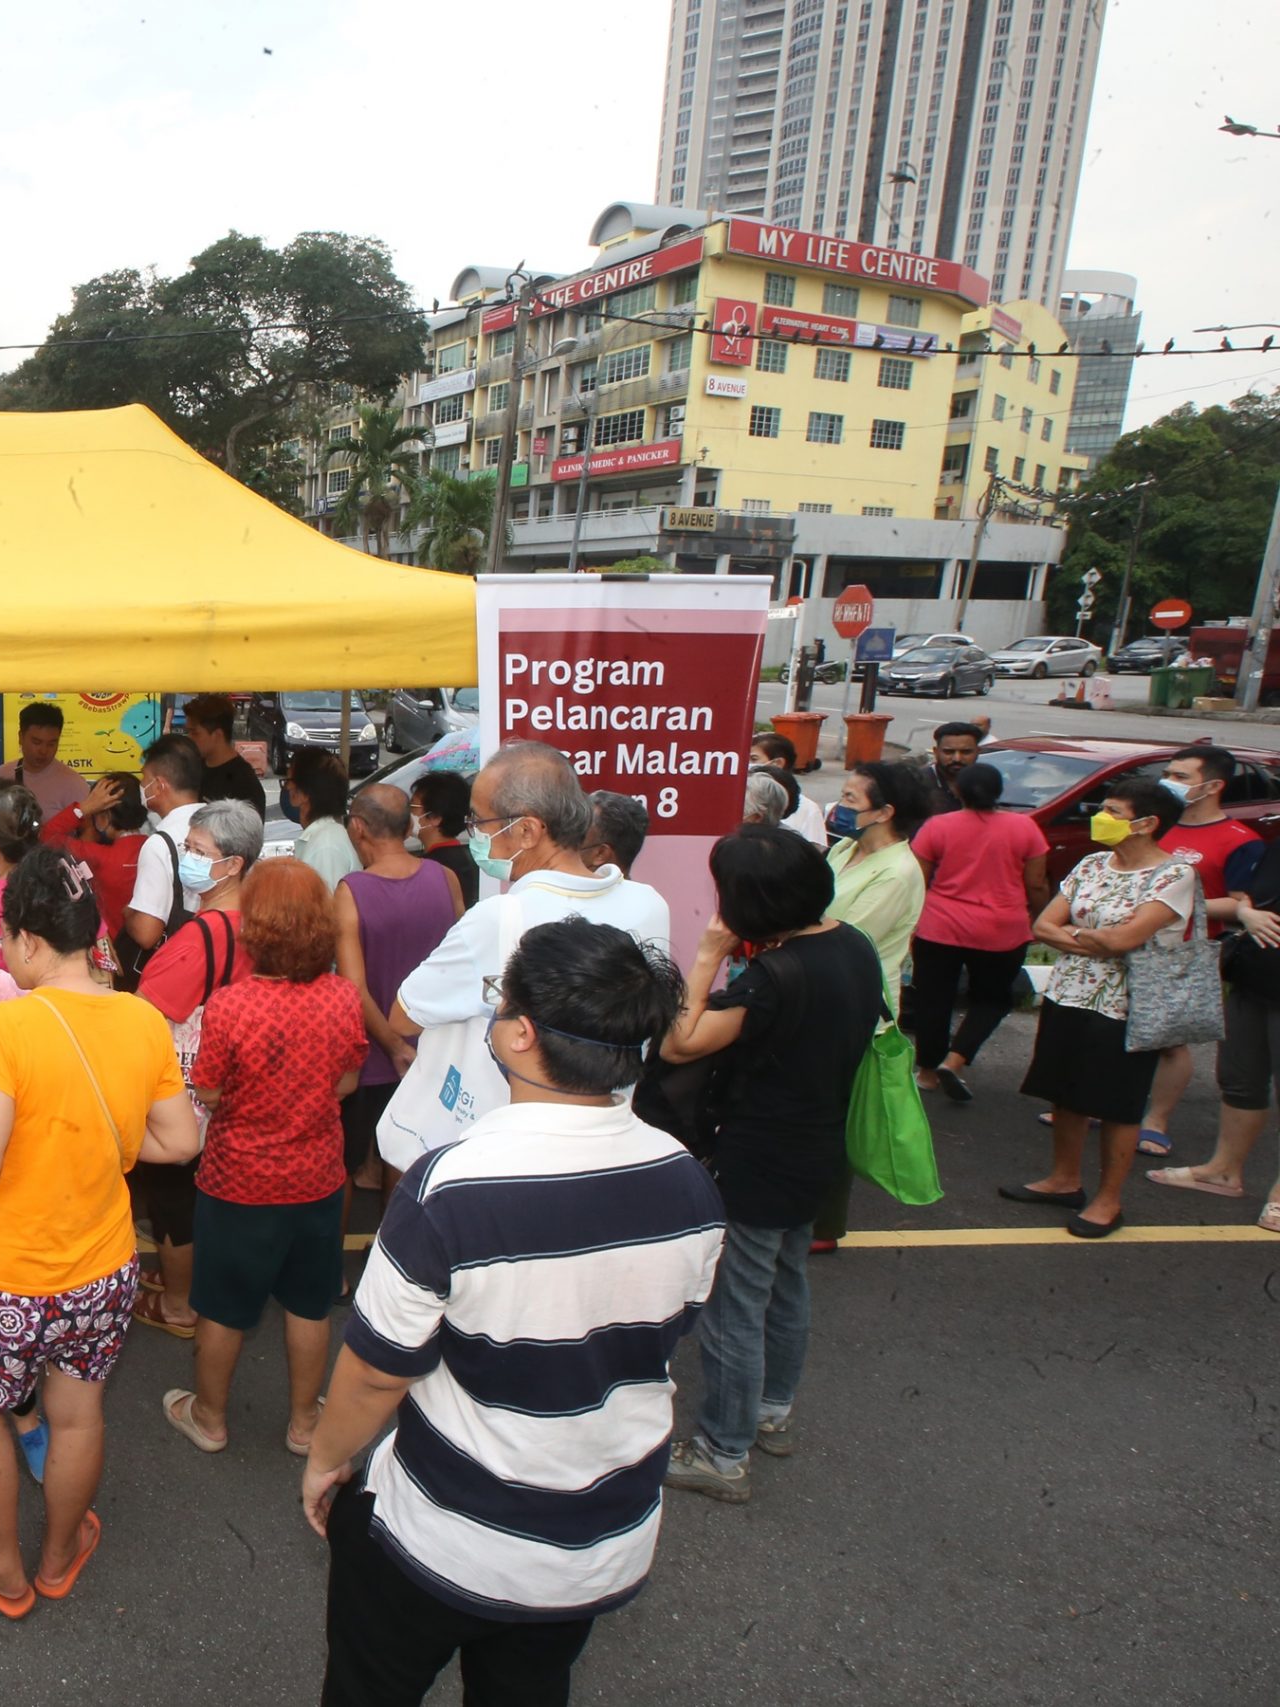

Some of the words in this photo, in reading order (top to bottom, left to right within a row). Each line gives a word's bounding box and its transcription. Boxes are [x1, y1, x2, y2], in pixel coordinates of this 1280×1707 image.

[758, 227, 795, 257] MY
[806, 239, 850, 269] LIFE
[861, 248, 939, 285] CENTRE
[541, 285, 575, 312] LIFE
[580, 257, 654, 298] CENTRE
[772, 316, 810, 330] ALTERNATIVE
[708, 378, 715, 390] 8
[716, 382, 746, 394] AVENUE
[617, 457, 624, 465] &
[626, 449, 669, 464] PANICKER
[670, 513, 676, 525] 8
[677, 513, 714, 527] AVENUE
[505, 653, 664, 694] Program
[505, 697, 713, 731] Pelancaran
[616, 742, 739, 775] Malam
[657, 786, 679, 818] 8
